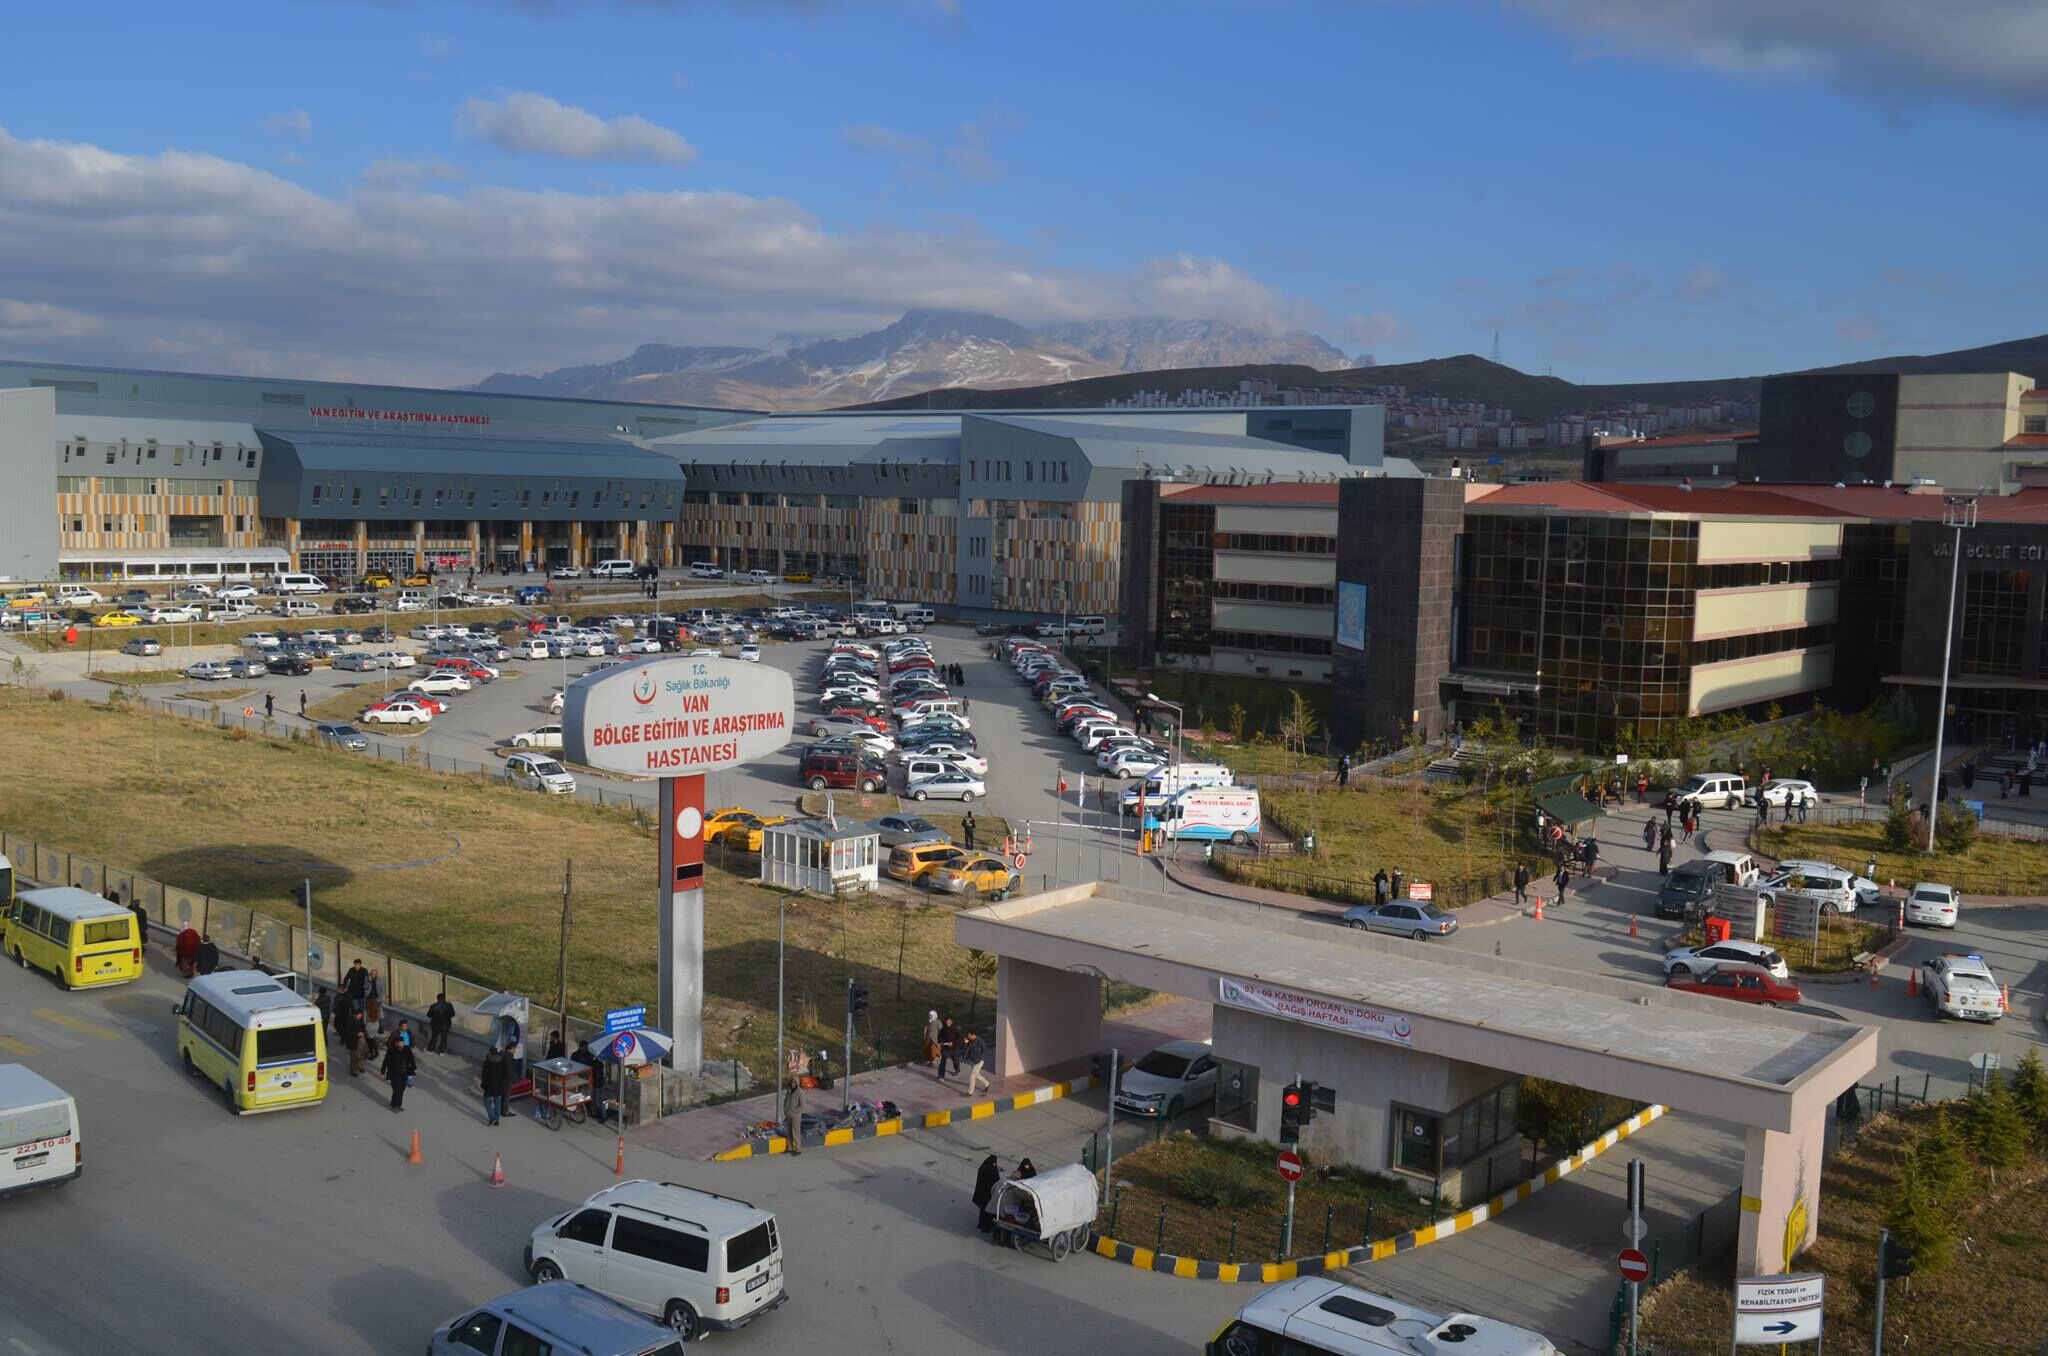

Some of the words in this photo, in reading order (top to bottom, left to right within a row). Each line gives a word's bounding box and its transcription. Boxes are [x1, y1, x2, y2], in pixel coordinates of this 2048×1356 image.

[310, 408, 330, 417] VAN
[368, 410, 381, 419] VE
[383, 411, 438, 423] ARAŞTIRMA
[692, 664, 708, 676] T.C.
[665, 679, 692, 694] Sağlık
[694, 676, 730, 690] Bakanlığı
[682, 695, 709, 713] VAN
[593, 723, 640, 746] BÖLGE
[644, 716, 689, 742] EĞİTİM
[693, 718, 709, 736] VE
[712, 712, 785, 737] ARAŞTIRMA
[647, 739, 737, 769] HASTANESİ
[1244, 984, 1255, 994] 03
[1275, 991, 1304, 1005] KASIM
[1307, 998, 1341, 1013] ORGAN
[1356, 1010, 1385, 1023] DOKU
[1308, 1010, 1348, 1025] HAFTASI
[16, 1143, 37, 1155] 223
[41, 1140, 55, 1149] 10
[58, 1136, 72, 1145] 45
[1757, 1288, 1775, 1296] FİZİK
[1777, 1287, 1799, 1295] TEDAVİ
